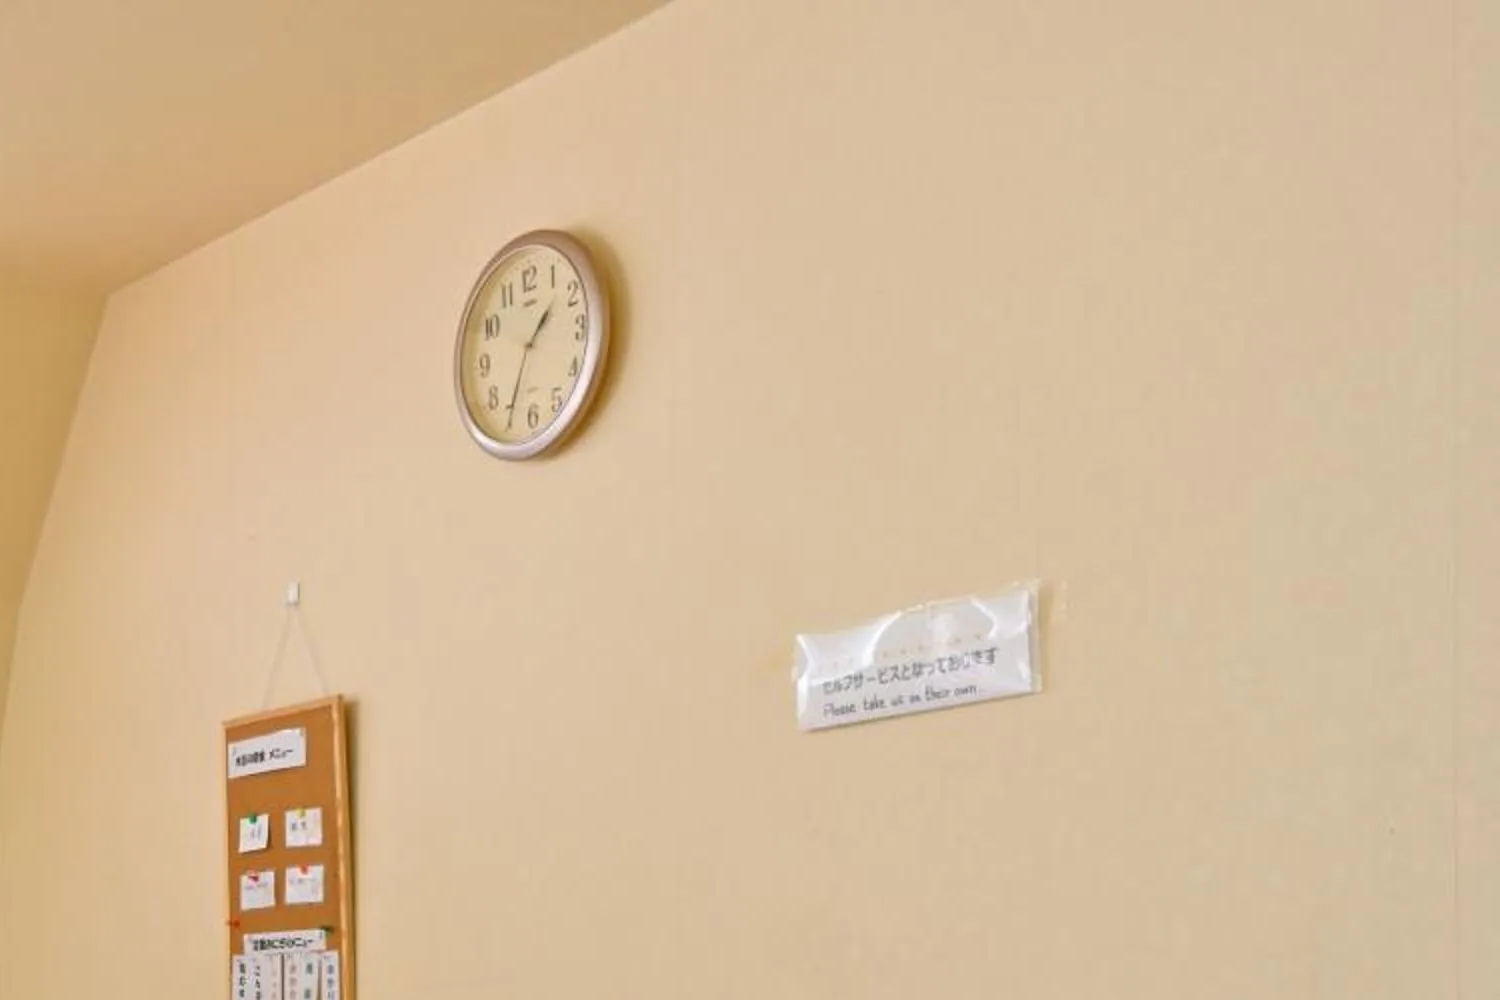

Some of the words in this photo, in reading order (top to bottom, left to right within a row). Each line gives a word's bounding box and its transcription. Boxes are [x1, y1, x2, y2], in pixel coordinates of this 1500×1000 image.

[521, 264, 538, 293] 12
[550, 264, 556, 289] 1
[500, 282, 514, 309] 11
[566, 280, 580, 307] 2
[484, 313, 500, 341] 10
[574, 313, 586, 341] 3
[478, 353, 492, 379] 9
[567, 356, 579, 378] 4
[487, 385, 500, 411] 8
[550, 386, 564, 413] 5
[504, 402, 515, 430] 7
[527, 403, 540, 430] 6
[823, 702, 857, 718] Please
[862, 694, 887, 711] take
